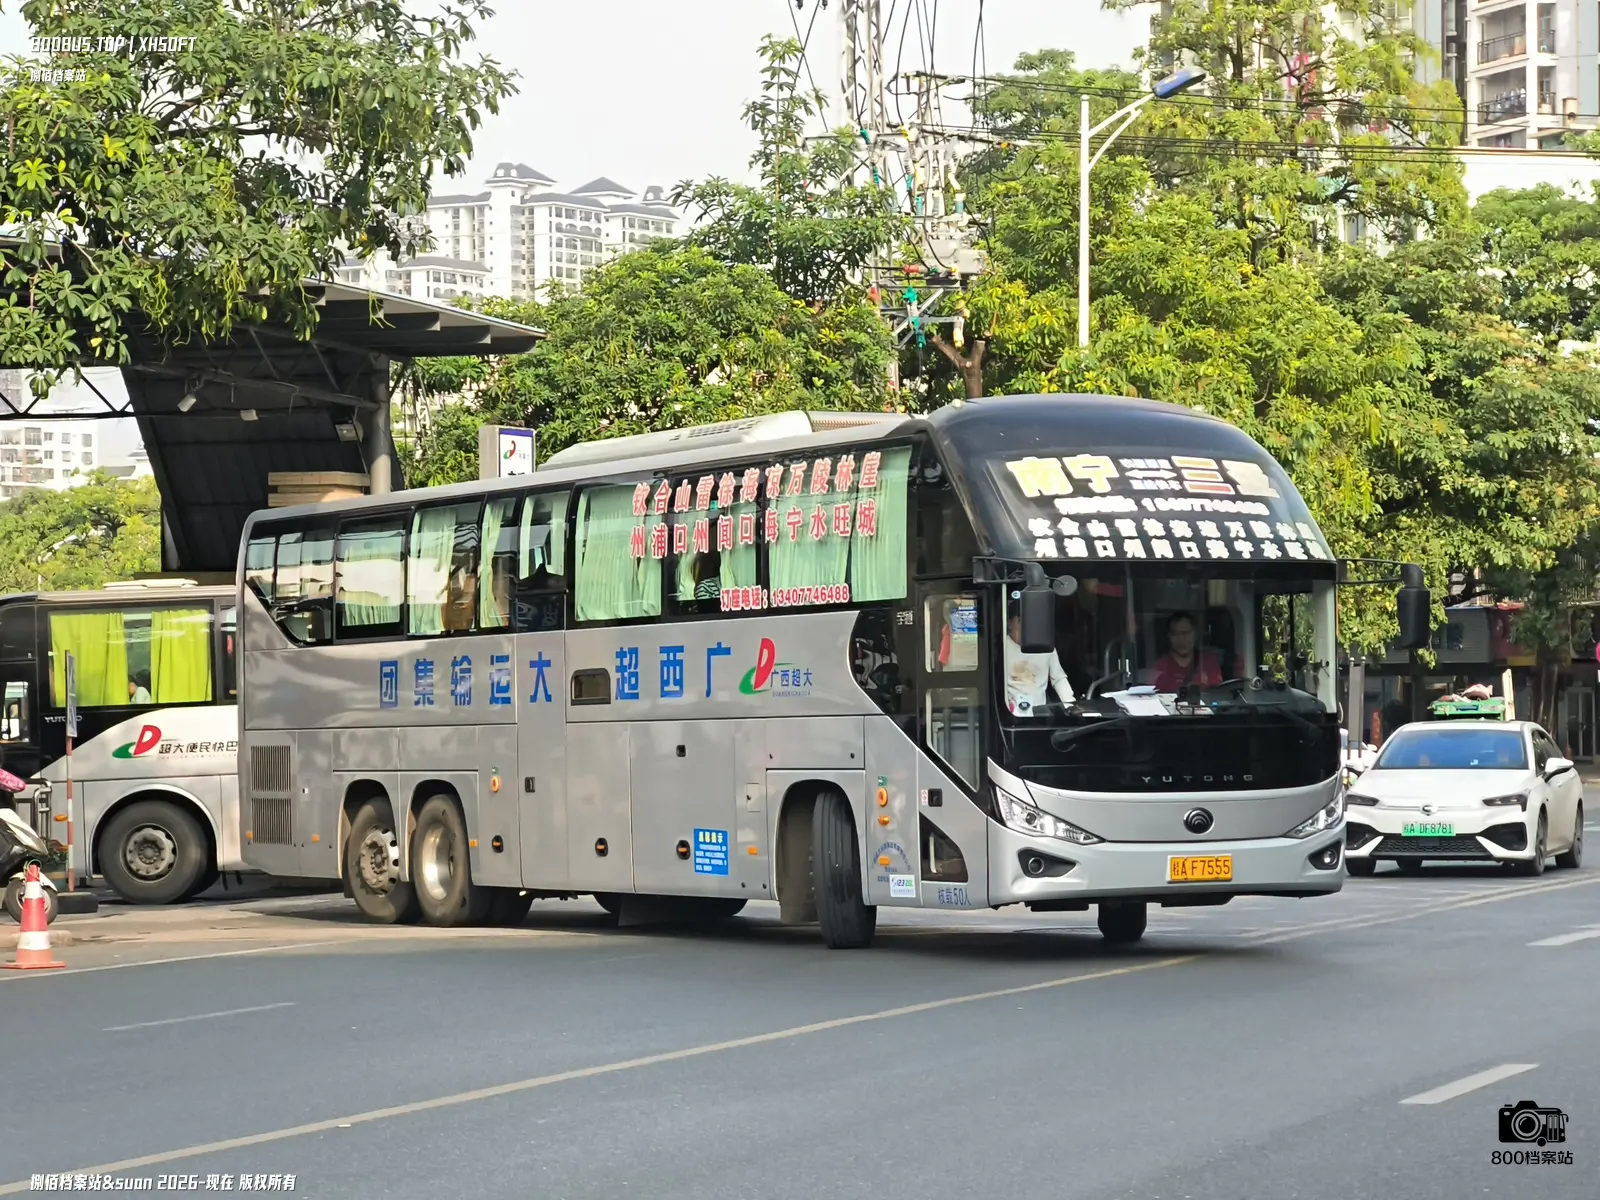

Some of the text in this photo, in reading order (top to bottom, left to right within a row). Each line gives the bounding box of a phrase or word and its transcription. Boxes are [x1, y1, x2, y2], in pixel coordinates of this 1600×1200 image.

[770, 668, 812, 687] 广西超大
[158, 741, 238, 754] 超大便民快巴
[1142, 775, 1253, 783] YUTONG
